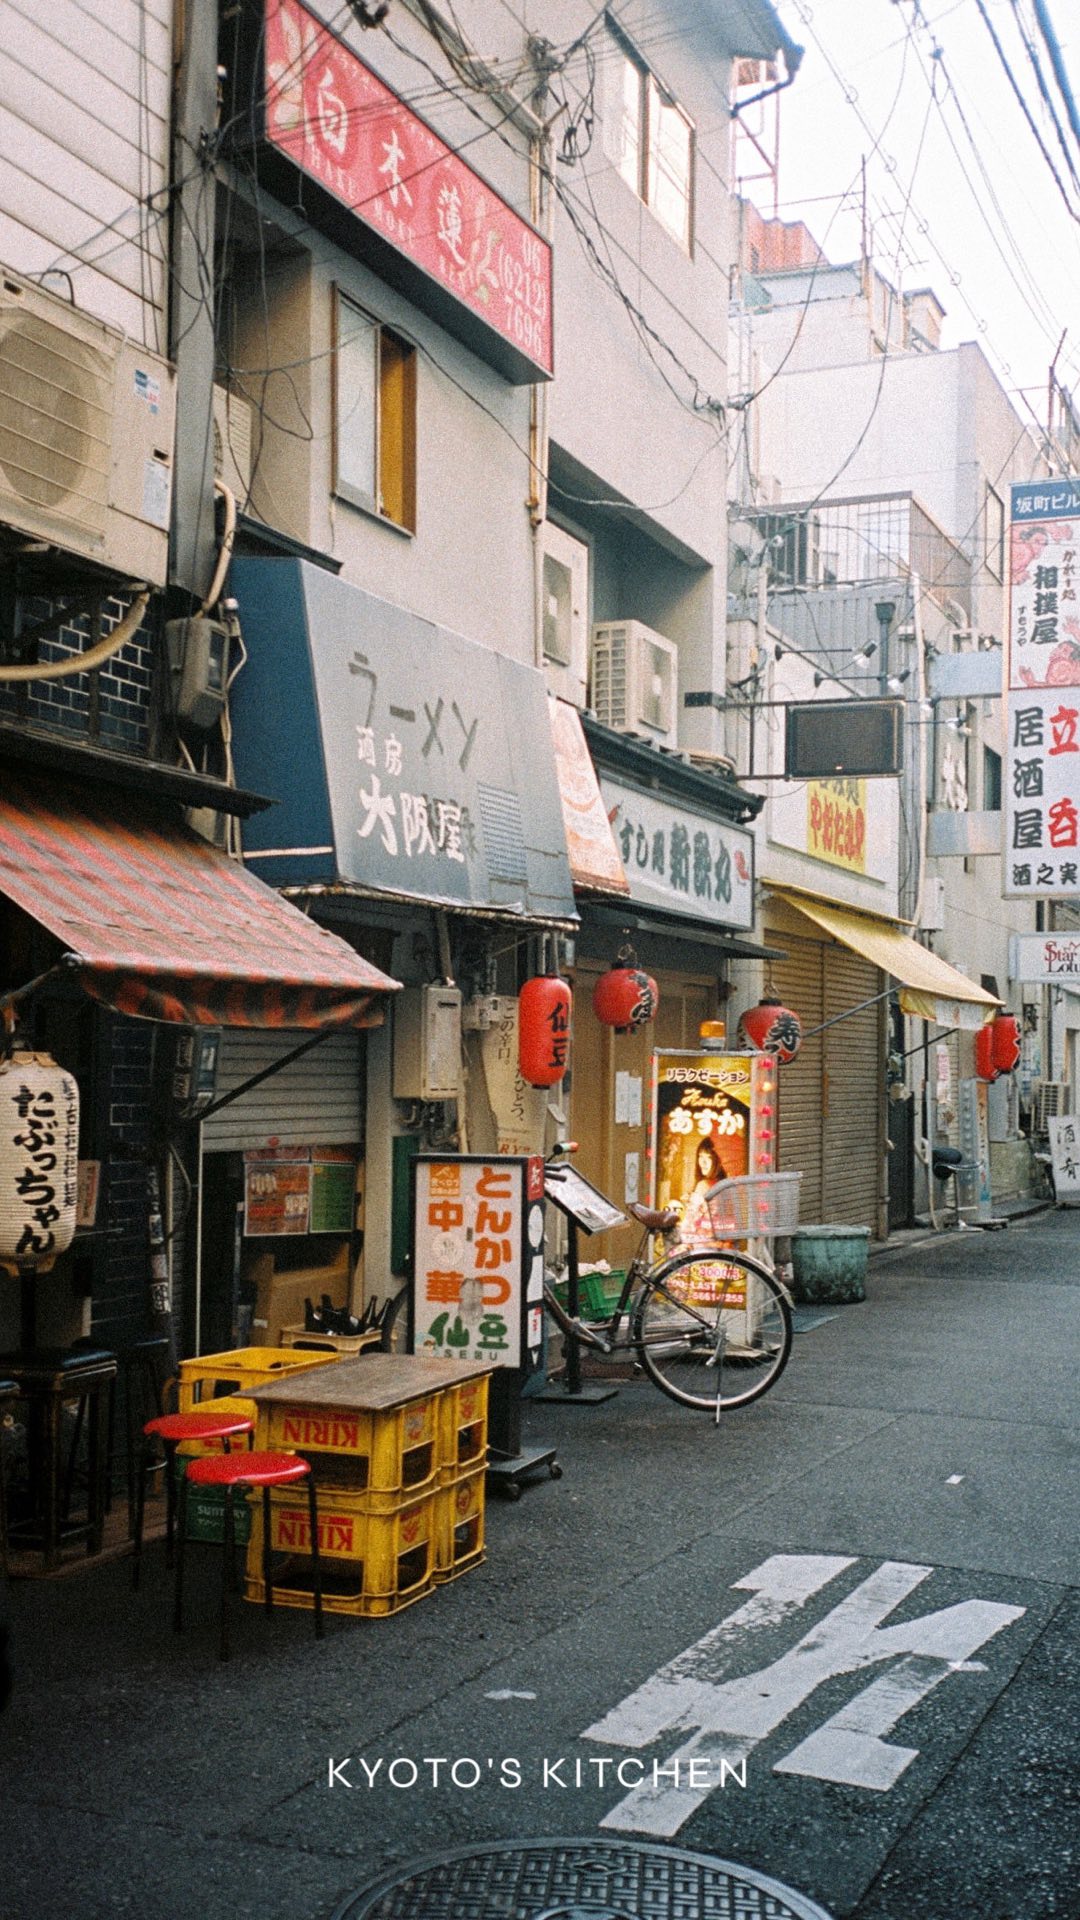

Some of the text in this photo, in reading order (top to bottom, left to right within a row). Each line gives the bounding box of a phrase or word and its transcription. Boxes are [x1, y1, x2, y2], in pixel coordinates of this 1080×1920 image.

[1030, 565, 1059, 645] 相撲屋
[357, 773, 465, 863] 大阪屋
[1012, 706, 1044, 849] 居酒屋
[1047, 705, 1080, 848] 立呑
[667, 1068, 748, 1083] リラクゼーション
[669, 1107, 745, 1135] あすか
[425, 1200, 467, 1304] 中華
[474, 1166, 513, 1306] とんかつ
[282, 1417, 359, 1448] KIRIN
